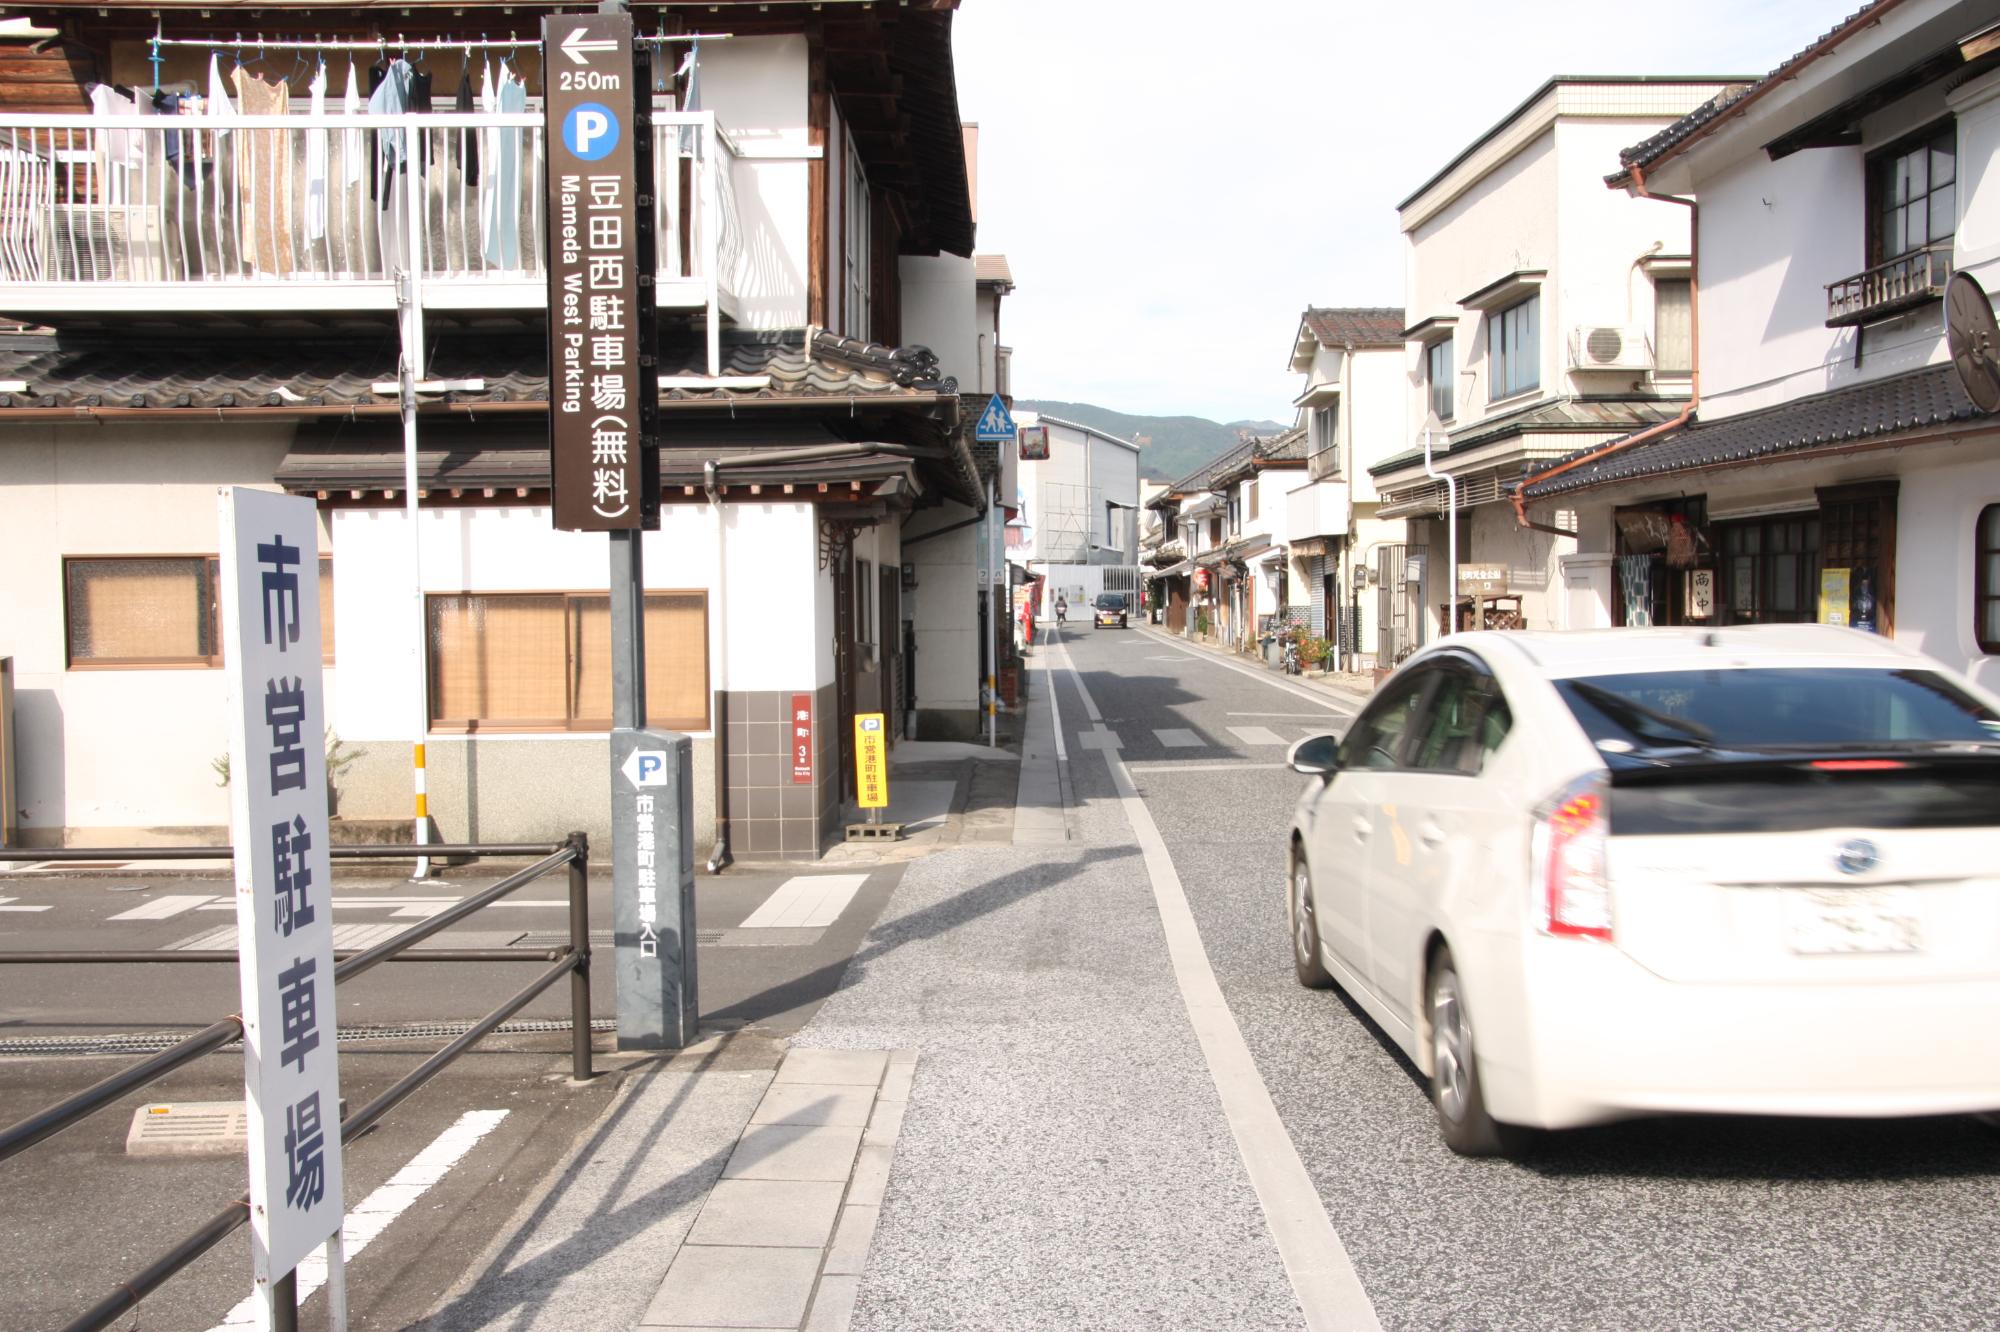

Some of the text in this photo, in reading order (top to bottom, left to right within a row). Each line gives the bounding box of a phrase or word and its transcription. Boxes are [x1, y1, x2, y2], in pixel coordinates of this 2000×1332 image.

[560, 71, 620, 91] 250m
[576, 111, 608, 152] P
[561, 175, 584, 412] Mameda West Parking
[587, 175, 629, 518] 豆田西駐車場（無料）
[1695, 572, 1710, 612] 商い中
[638, 755, 662, 781] P
[257, 534, 326, 1213] 市営駐車場
[636, 794, 657, 958] 市営港町駐車場入口
